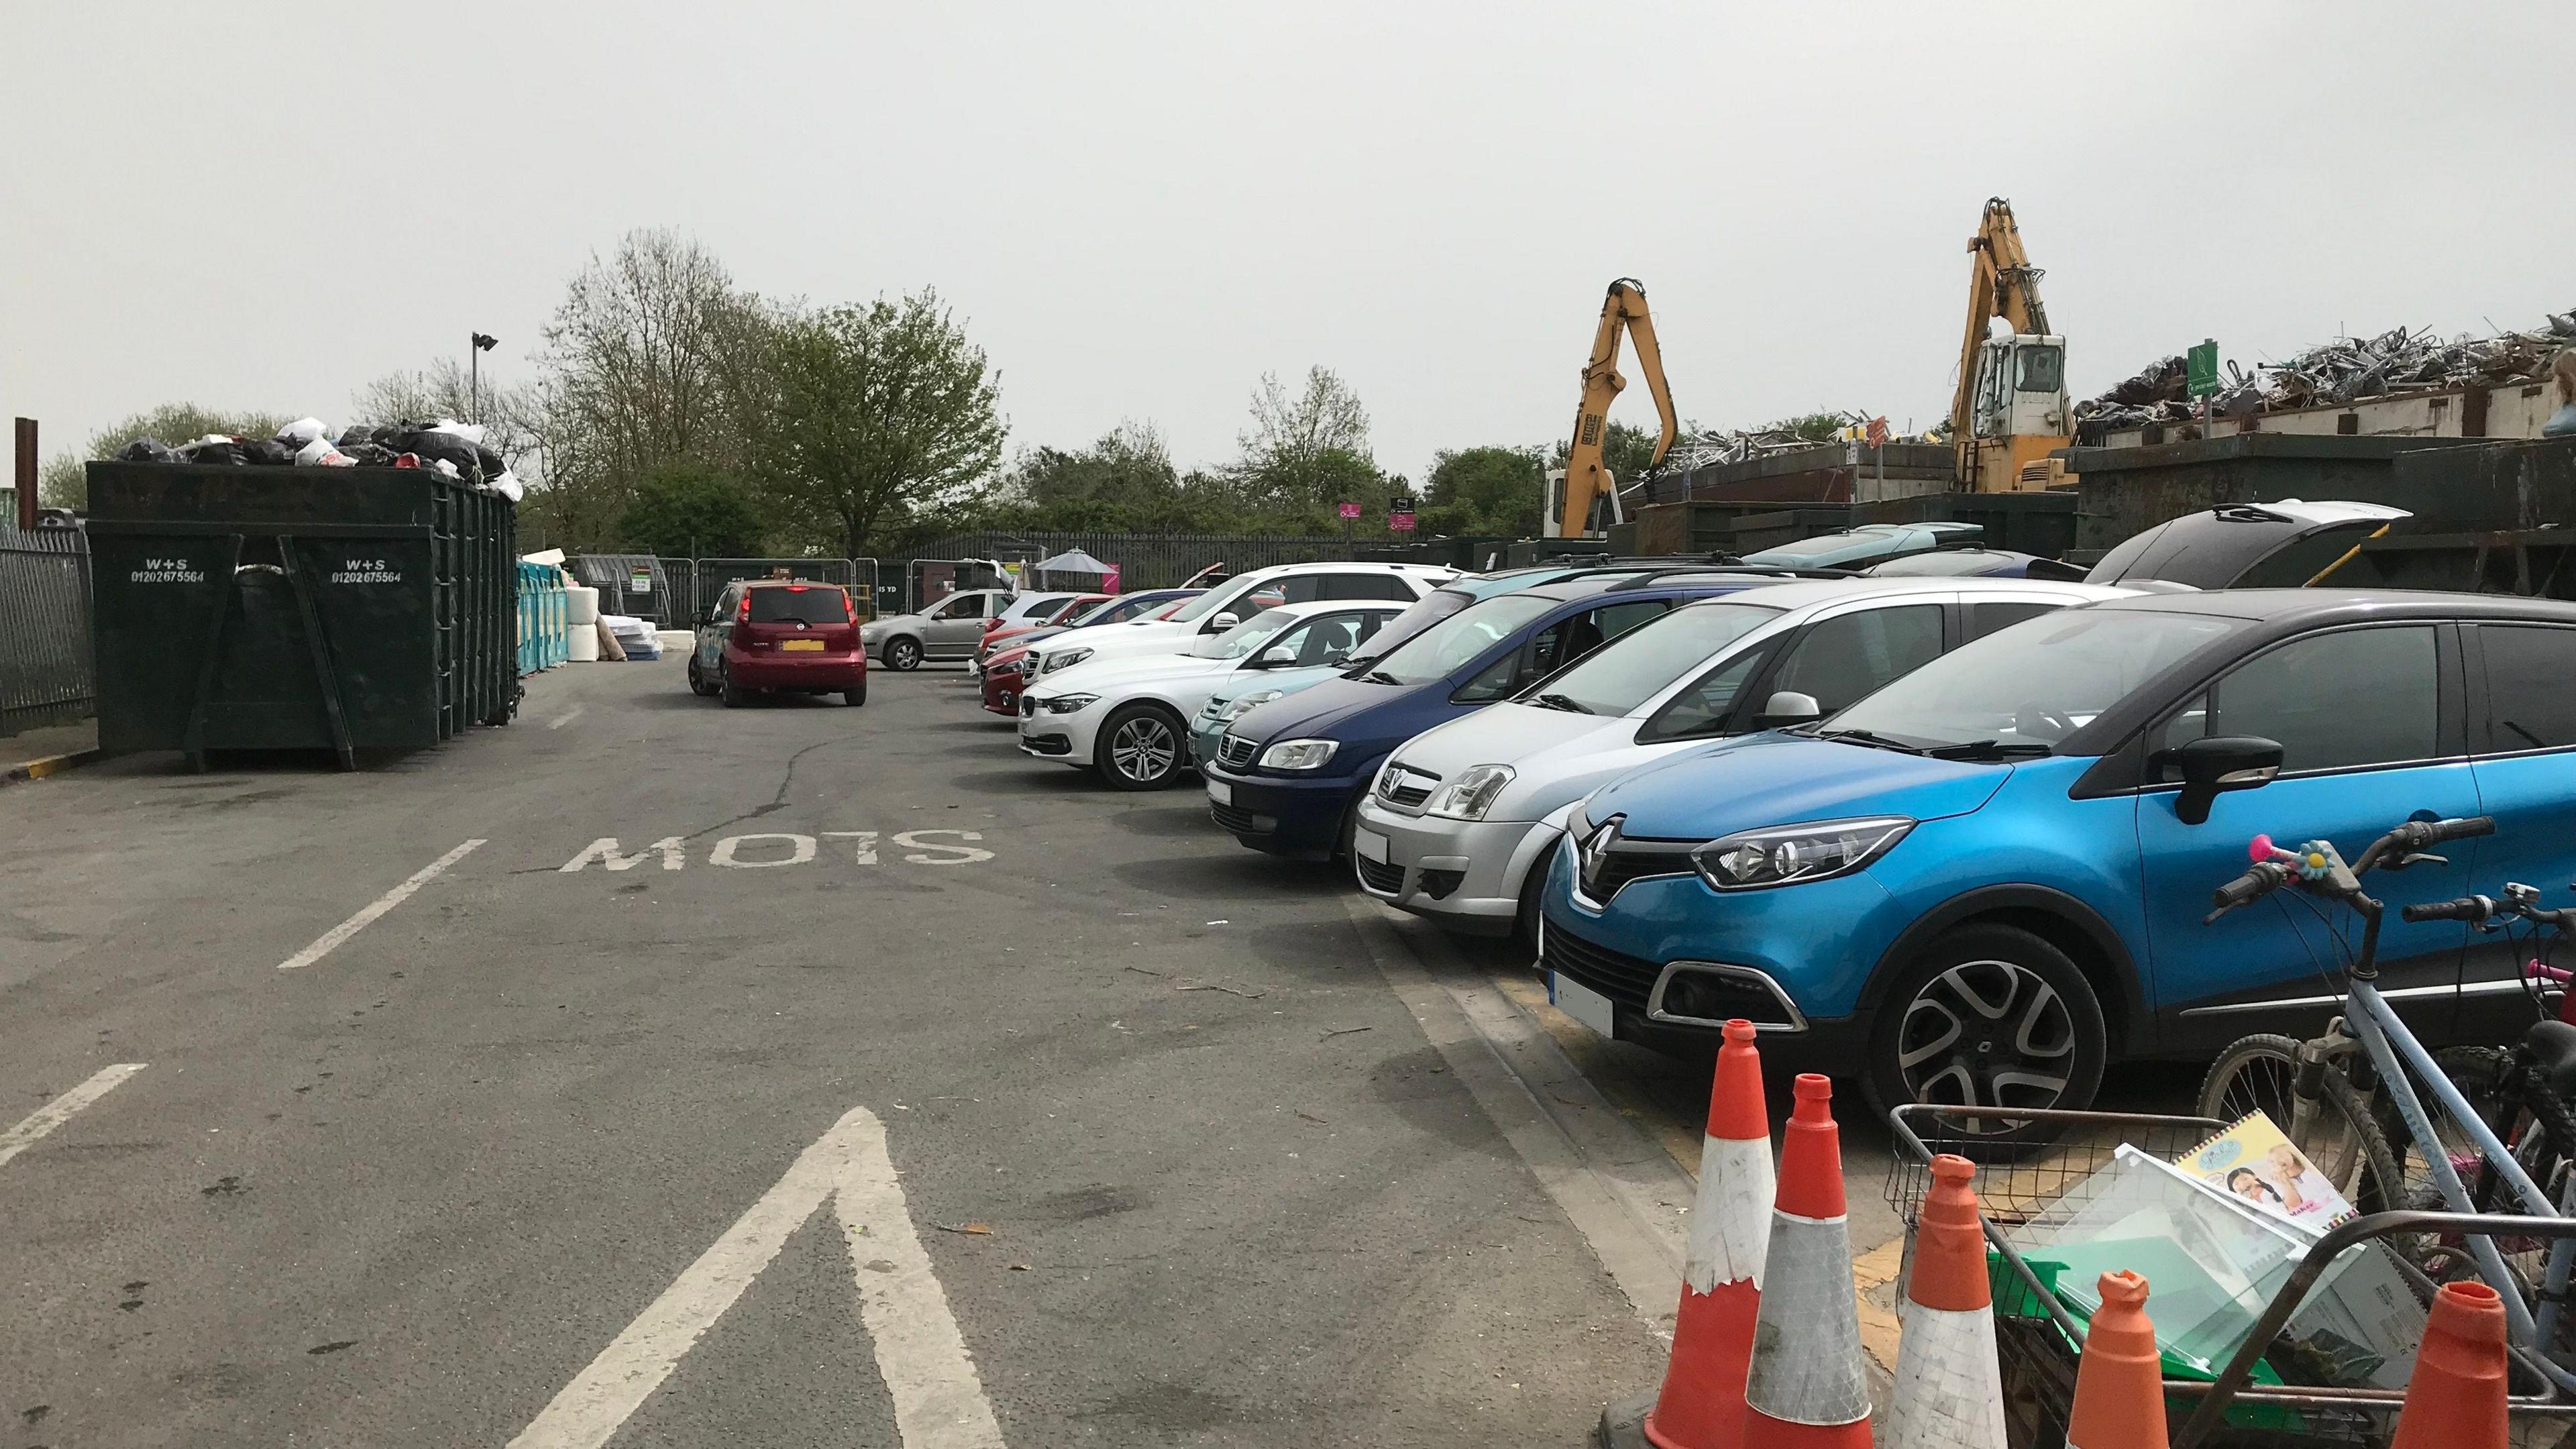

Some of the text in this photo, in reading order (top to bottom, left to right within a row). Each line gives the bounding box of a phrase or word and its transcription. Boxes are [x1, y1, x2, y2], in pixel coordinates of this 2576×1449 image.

[131, 571, 204, 582] 01202675564
[332, 572, 400, 583] 01202675564
[559, 829, 995, 872] SLOW
